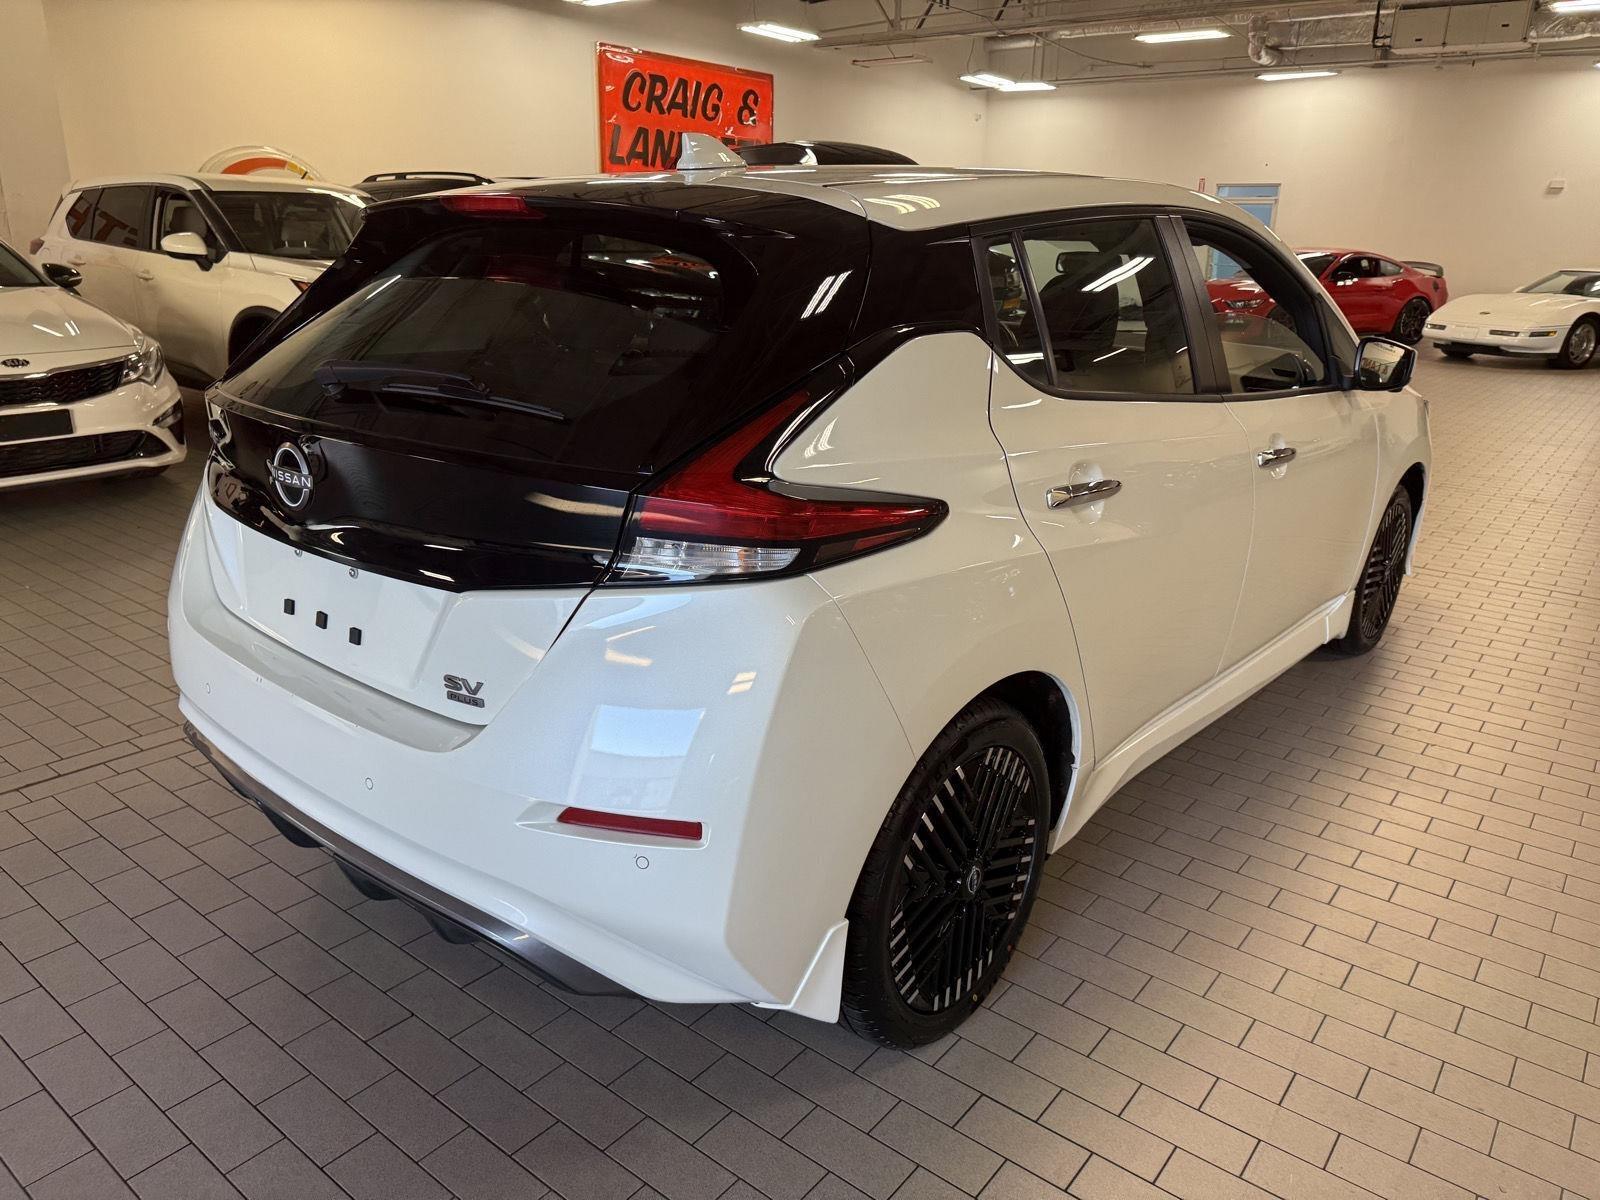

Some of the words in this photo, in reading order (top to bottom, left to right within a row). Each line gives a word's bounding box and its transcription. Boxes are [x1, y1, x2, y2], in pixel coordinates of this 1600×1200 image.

[621, 70, 724, 122] CRAIG
[737, 89, 760, 126] &
[271, 467, 311, 487] NISSAN
[444, 674, 484, 696] SV
[449, 692, 480, 706] PLUS
